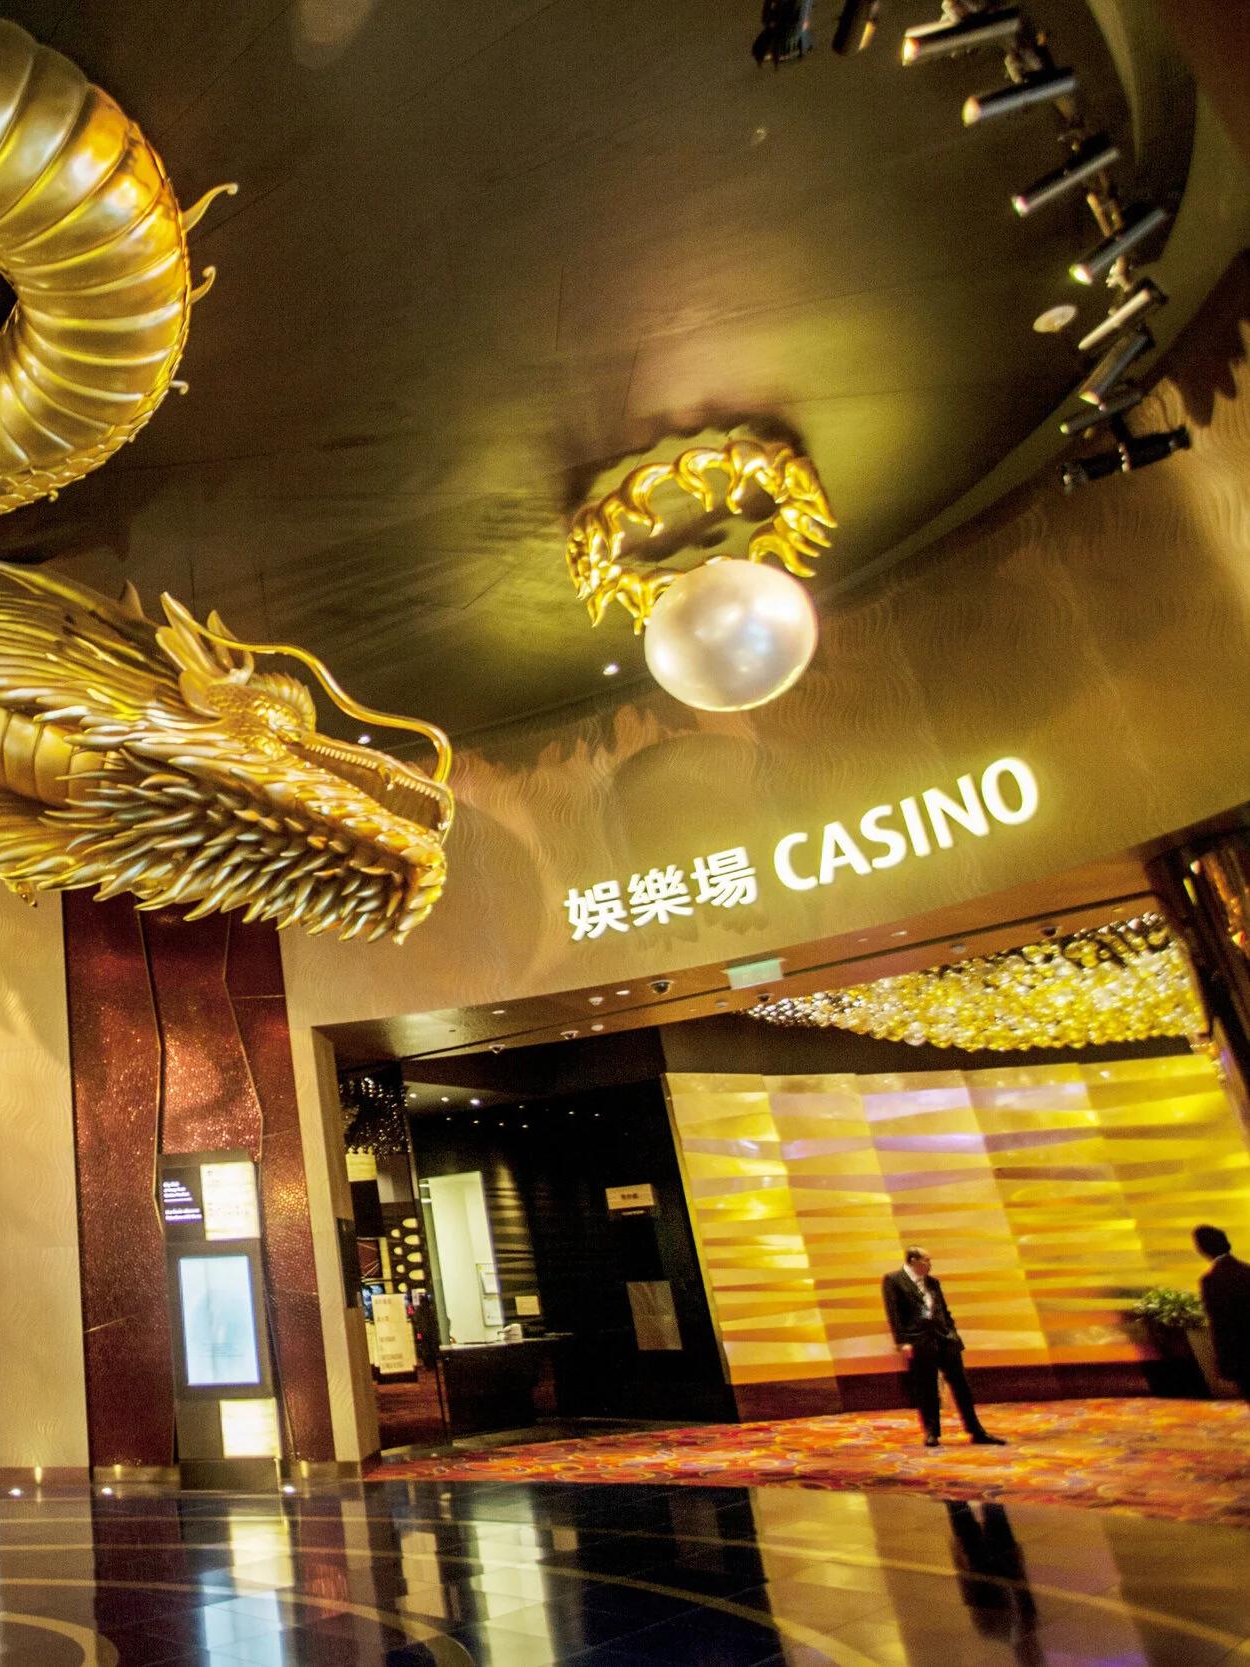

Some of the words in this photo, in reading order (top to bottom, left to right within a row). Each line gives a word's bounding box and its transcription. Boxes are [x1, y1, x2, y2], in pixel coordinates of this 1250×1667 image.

[564, 846, 757, 941] 娛樂場
[773, 756, 1040, 891] CASINO
